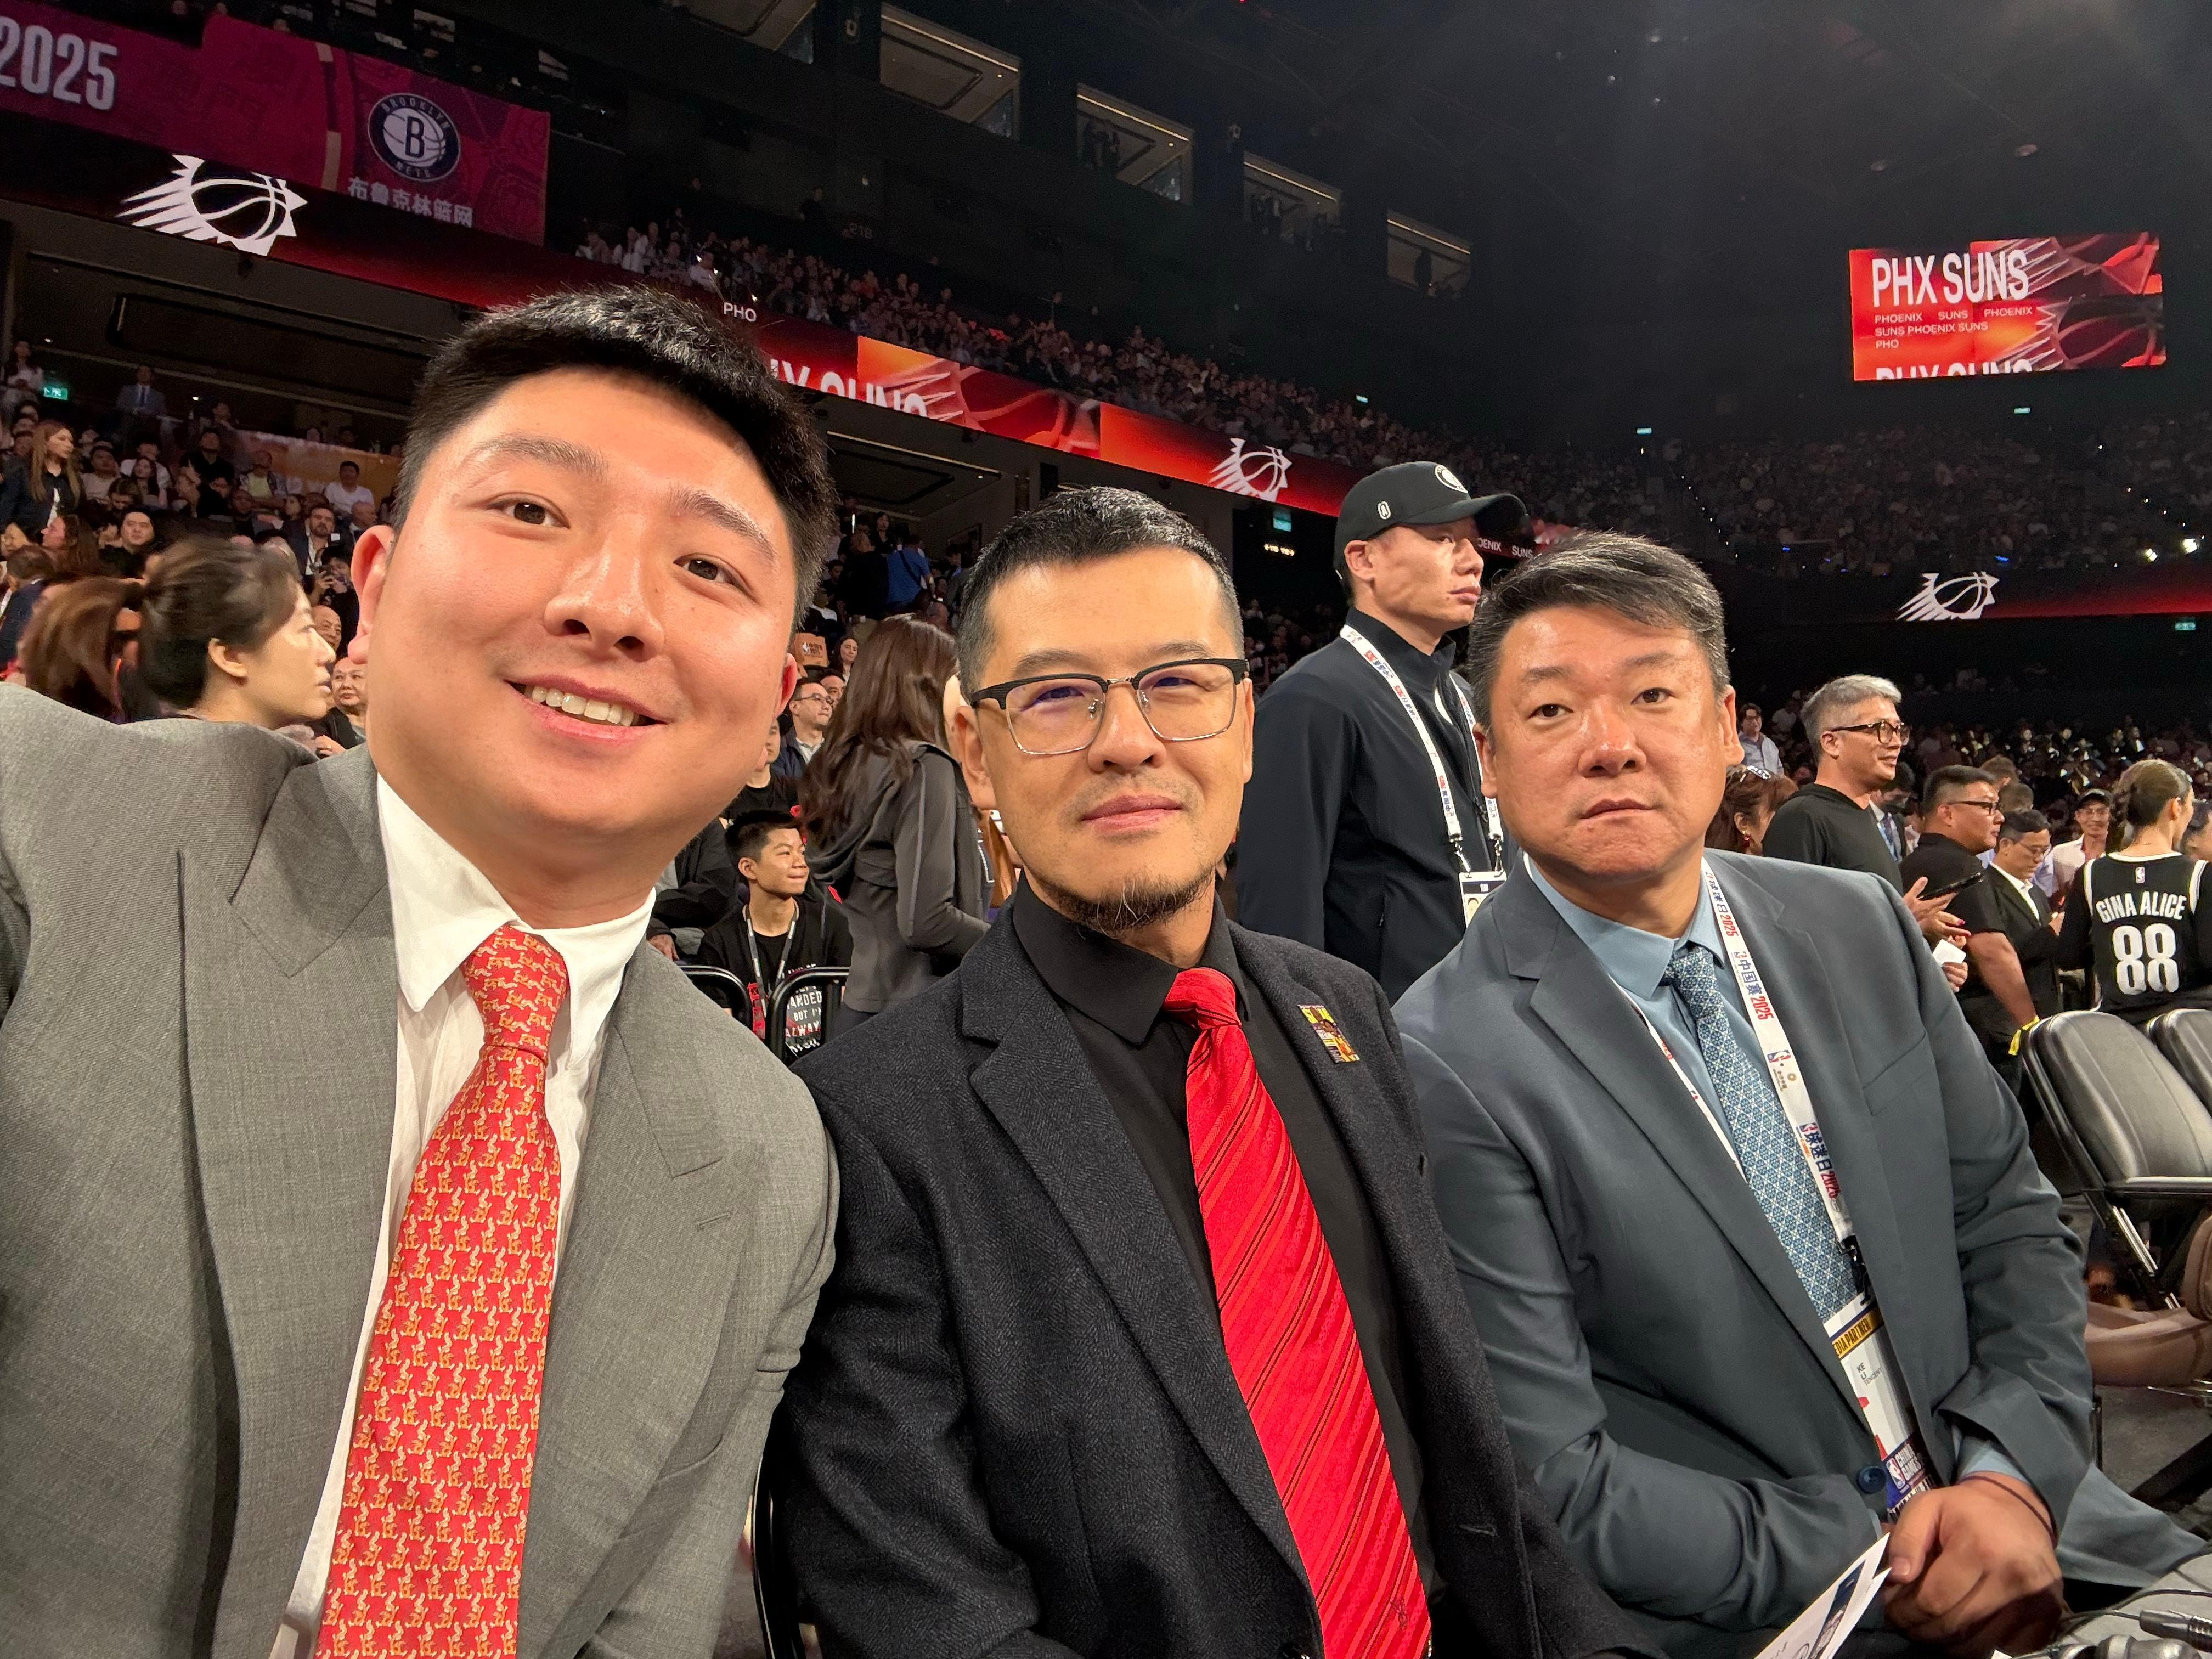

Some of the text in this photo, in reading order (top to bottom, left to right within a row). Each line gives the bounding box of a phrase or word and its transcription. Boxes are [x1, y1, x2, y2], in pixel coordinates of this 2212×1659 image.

[0, 16, 117, 111] 2025
[381, 97, 451, 129] BROOKLYN
[405, 116, 425, 158] B
[1872, 249, 2029, 307] PHX SUNS
[724, 301, 757, 322] PHO
[1875, 307, 2033, 324] PHOENIX SUNS PHOENIX
[1875, 321, 1988, 337] SUNS PHOENIX SUNS
[1875, 339, 1899, 349] PHO
[1511, 545, 1533, 559] SUNS
[2096, 891, 2187, 923] GINA ALICE
[2113, 923, 2179, 995] 88
[787, 991, 822, 1009] ANDED
[793, 1009, 808, 1022] BUT
[785, 1020, 821, 1037] ALWAY
[1833, 1318, 1871, 1356] EDIA PARTNER
[1857, 1362, 1866, 1372] KE
